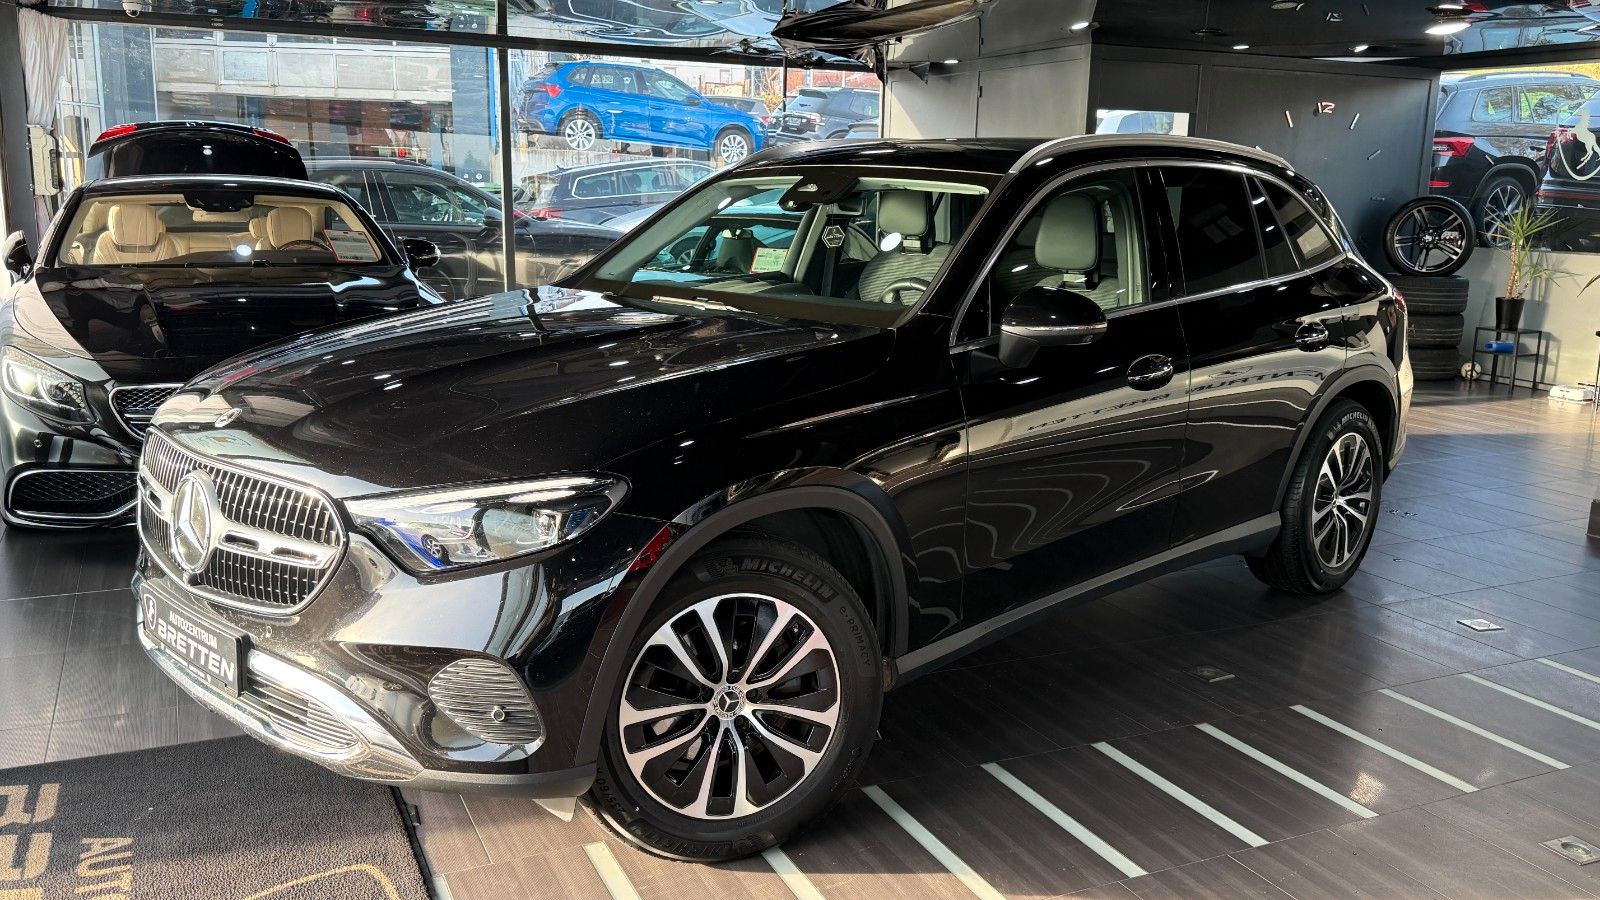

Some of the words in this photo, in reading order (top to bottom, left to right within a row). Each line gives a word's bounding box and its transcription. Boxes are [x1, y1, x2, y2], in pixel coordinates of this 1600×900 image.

[741, 558, 836, 599] MICHELIN
[157, 618, 235, 682] BRETTEN
[169, 611, 218, 649] AUTOZENTRUM
